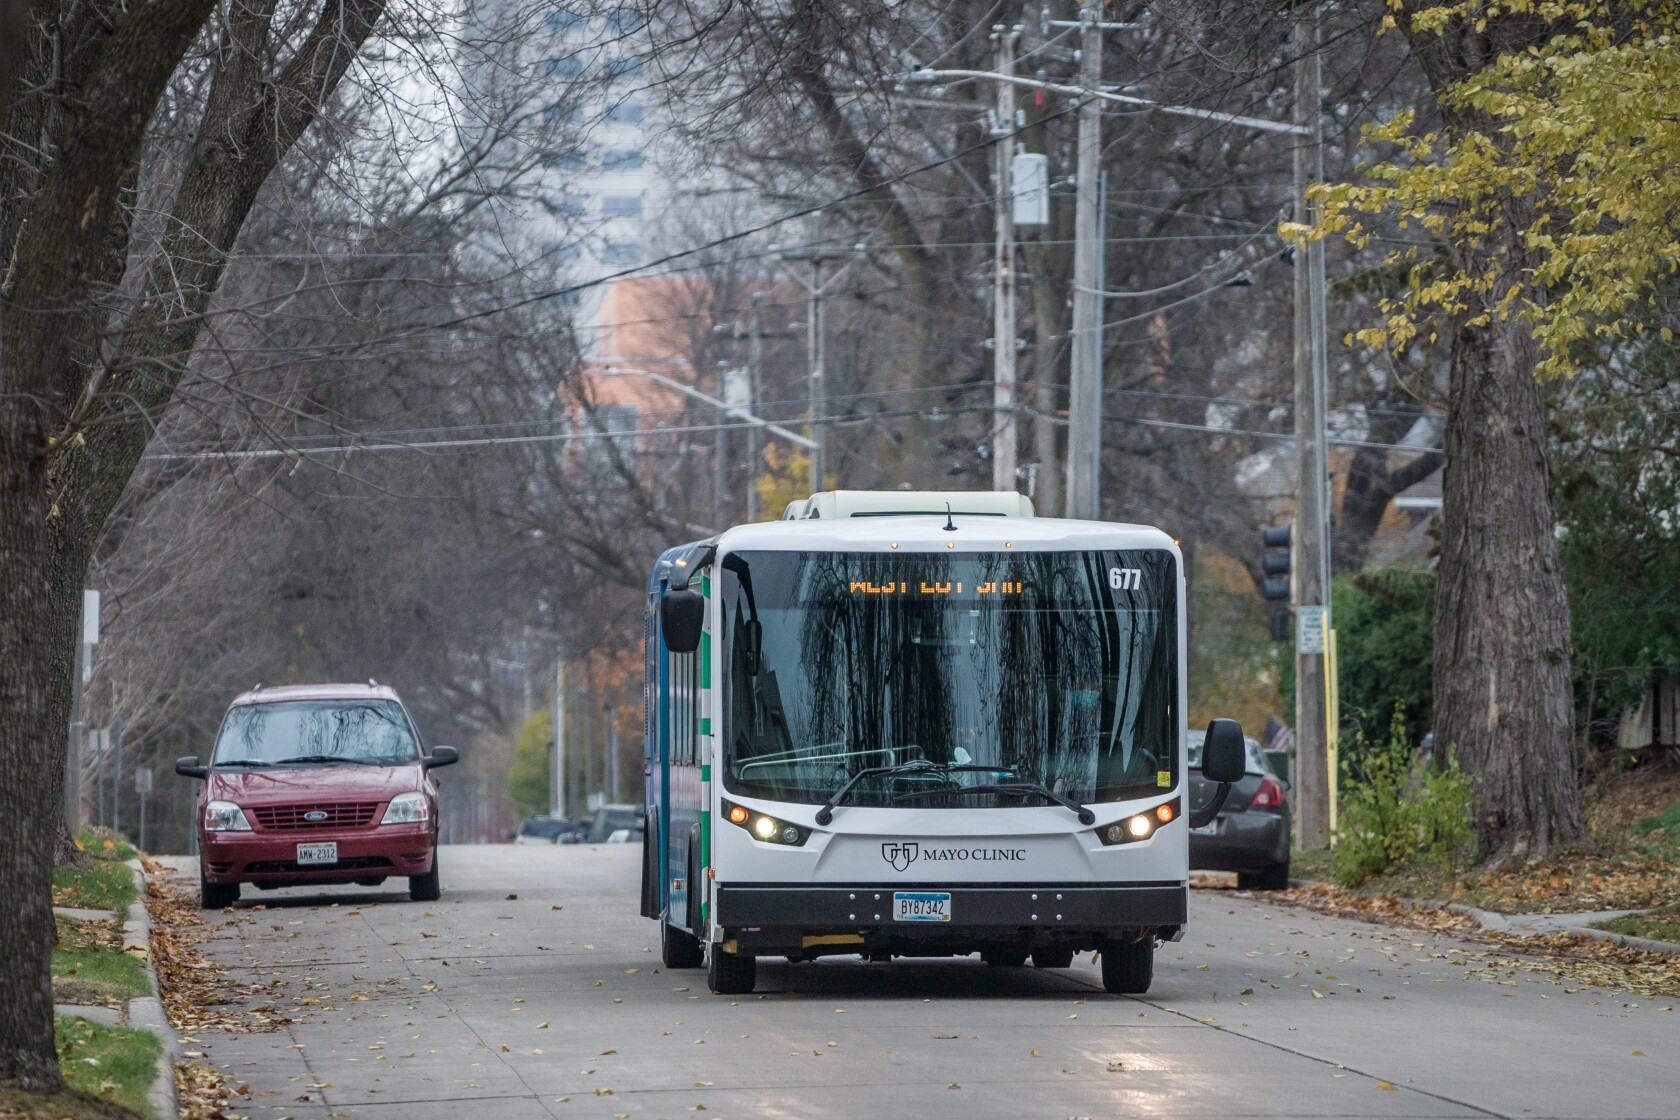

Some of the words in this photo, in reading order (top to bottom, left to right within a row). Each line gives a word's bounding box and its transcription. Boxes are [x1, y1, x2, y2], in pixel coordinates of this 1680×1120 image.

[1110, 567, 1141, 590] 677
[299, 848, 336, 860] AMW-2312
[923, 848, 969, 861] MAYO
[971, 848, 1026, 861] CLINIC
[901, 900, 944, 915] BY87342
